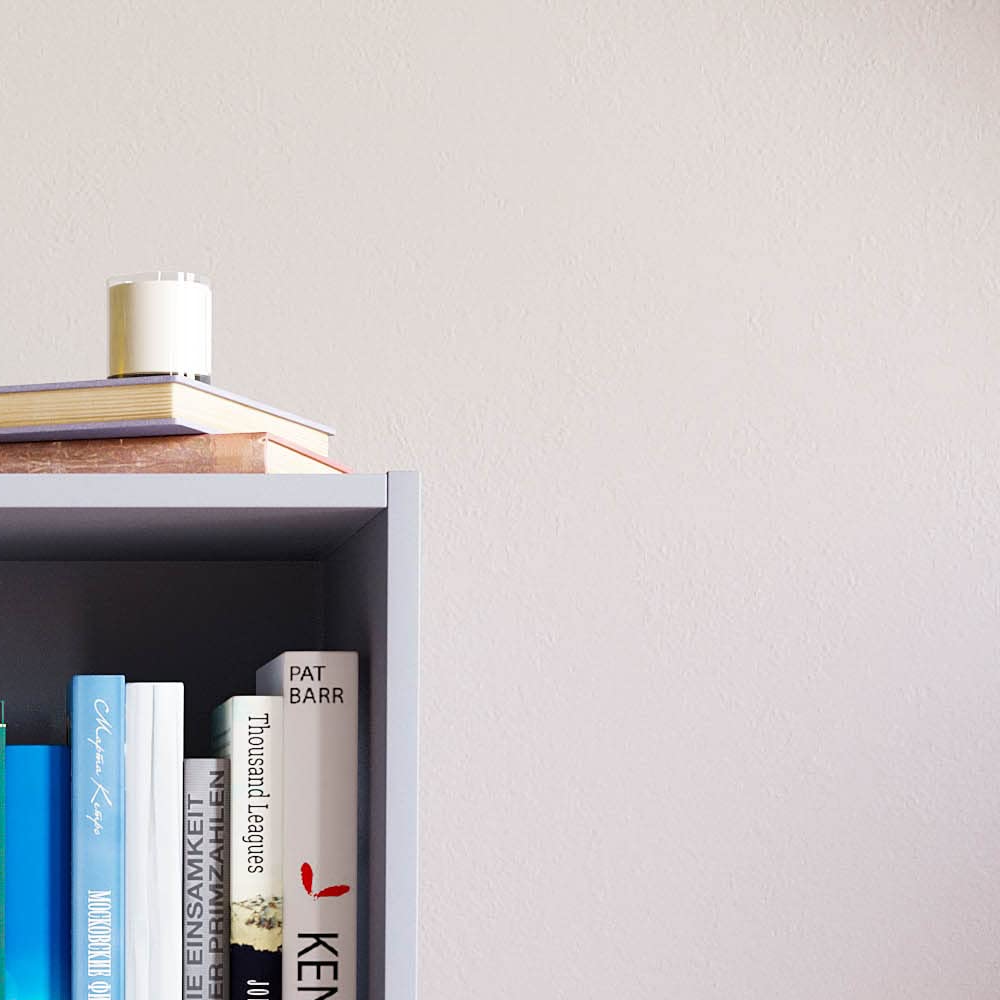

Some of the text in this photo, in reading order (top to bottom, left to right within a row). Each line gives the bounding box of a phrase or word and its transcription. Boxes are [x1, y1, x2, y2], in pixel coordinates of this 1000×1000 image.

[289, 666, 326, 682] PAT
[289, 688, 344, 704] BARR
[88, 699, 112, 776] Марта
[242, 713, 270, 873] Thousand Leagues
[186, 794, 204, 965] EINSAMKEIT
[208, 770, 224, 953] PRIMZAHLEN
[88, 889, 112, 977] МОСКОВСКИЕ
